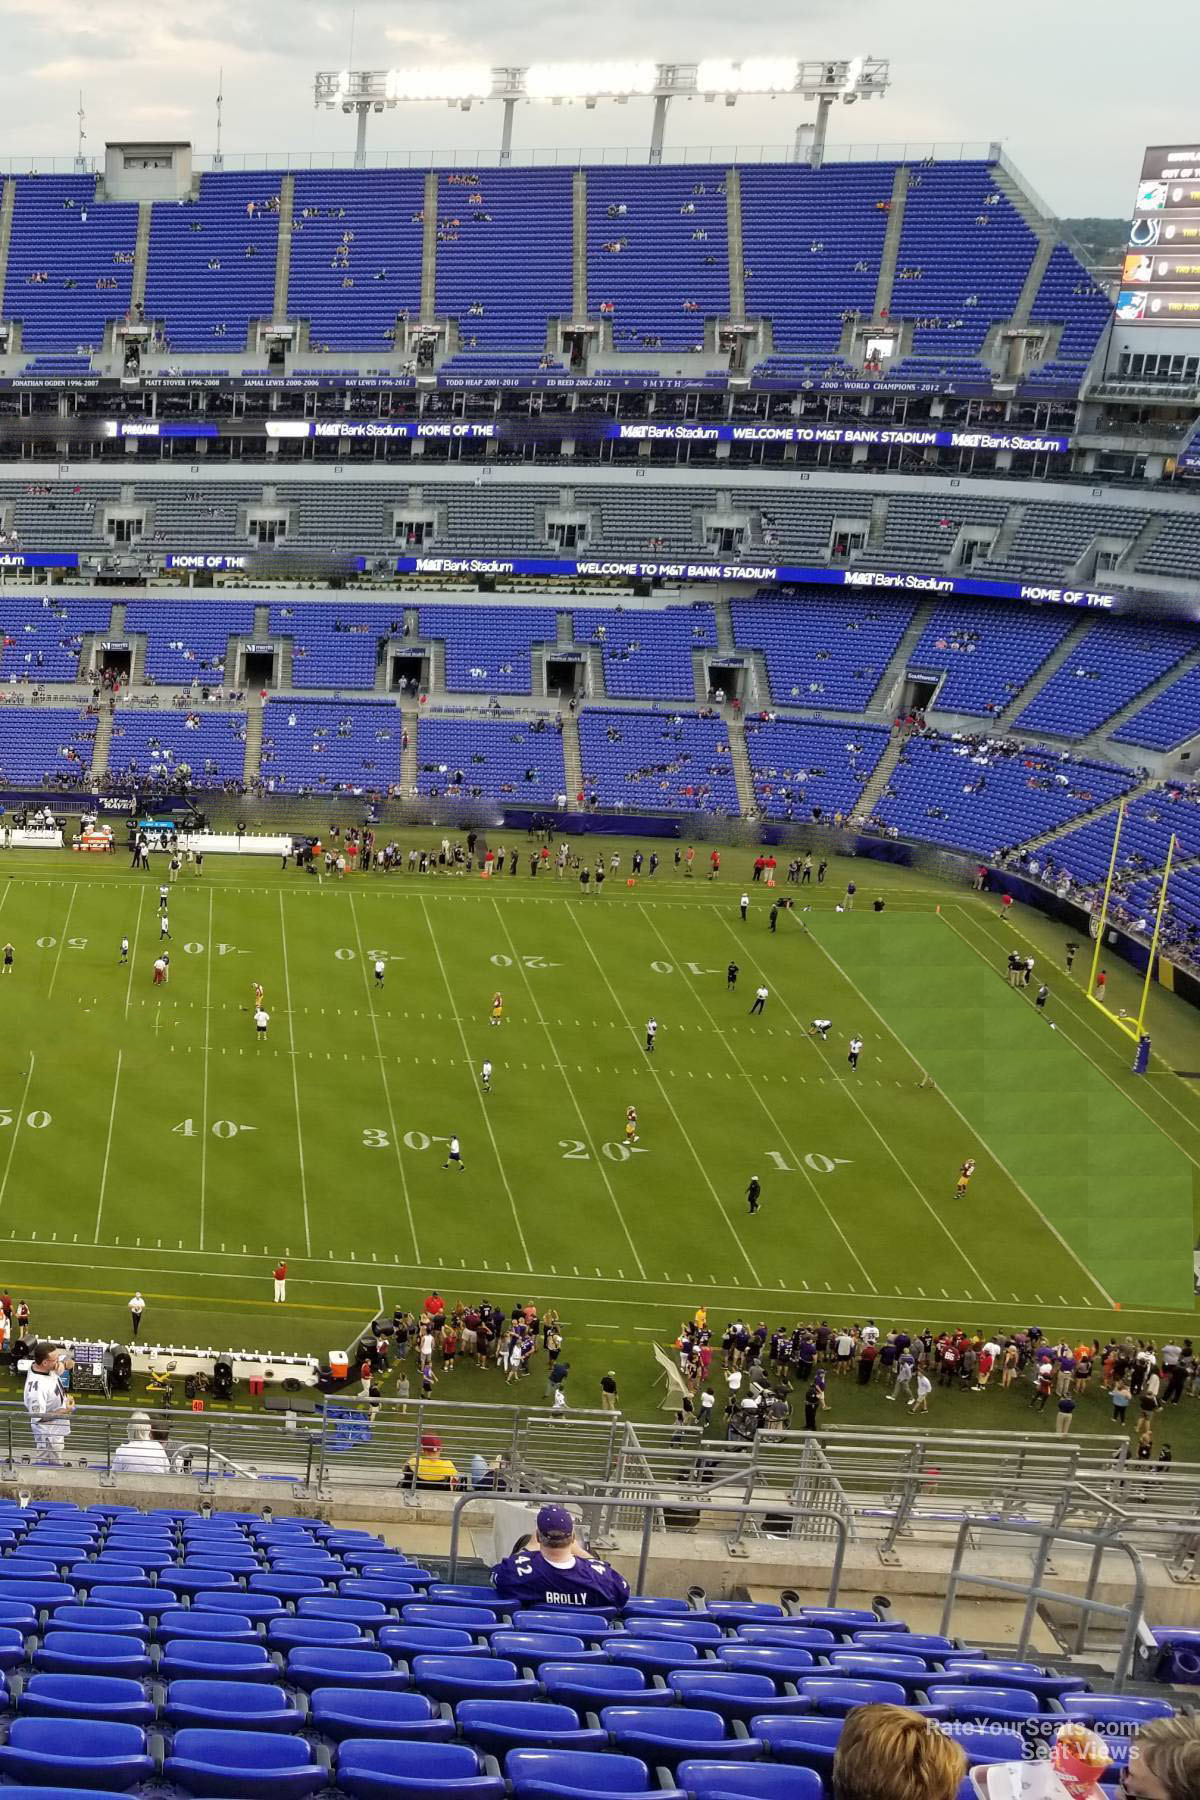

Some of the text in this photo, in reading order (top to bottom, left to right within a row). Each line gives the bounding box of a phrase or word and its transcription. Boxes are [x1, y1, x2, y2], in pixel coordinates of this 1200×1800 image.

[12, 379, 43, 387] JONATHAN
[643, 380, 681, 388] SMYTH
[844, 382, 870, 390] WORLD
[873, 383, 916, 391] CHAMPIONS
[341, 424, 365, 435] Bank
[366, 424, 406, 437] Stadium
[417, 425, 494, 436] HOME OF THE
[620, 426, 718, 439] M&T Bank Stadium
[733, 428, 936, 444] WELCOME TO M&T BANK STADIUM
[951, 433, 1059, 451] M&T Bank Stadium
[172, 556, 204, 567] HOME
[206, 556, 222, 567] OF
[444, 559, 468, 571] Bank
[470, 560, 513, 573] Stadium
[577, 562, 776, 579] WELCOME TO M&T BANK STADIUM
[844, 572, 954, 592] M&T Bank Stadium
[1021, 586, 1113, 607] HOME OF THE
[28, 1381, 39, 1392] 74
[193, 1401, 203, 1411] 40
[515, 1555, 533, 1577] 42
[545, 1591, 587, 1605] BROLLY
